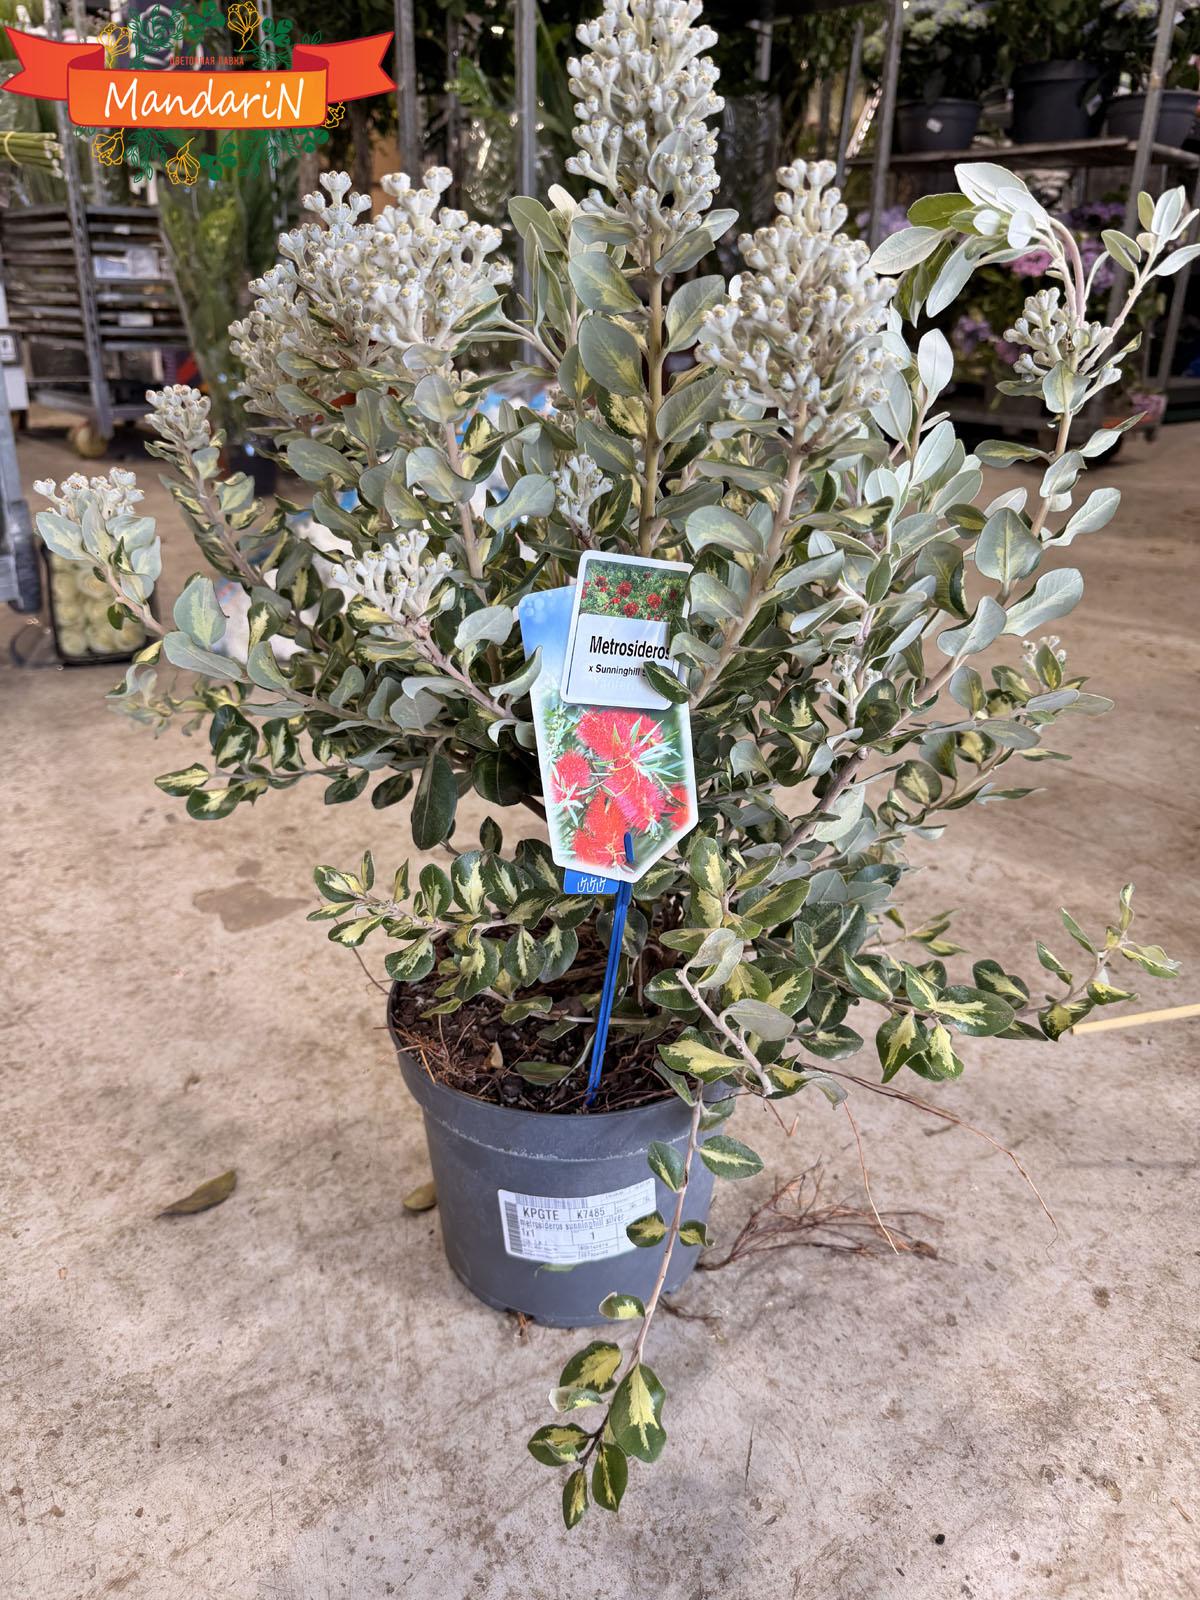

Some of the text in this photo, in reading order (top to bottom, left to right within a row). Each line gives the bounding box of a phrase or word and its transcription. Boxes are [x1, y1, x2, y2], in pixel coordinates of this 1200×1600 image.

[589, 635, 669, 660] Metrosideros
[588, 665, 594, 673] x
[595, 664, 640, 677] Sunninghill
[523, 1207, 605, 1220] KPGTE K7485
